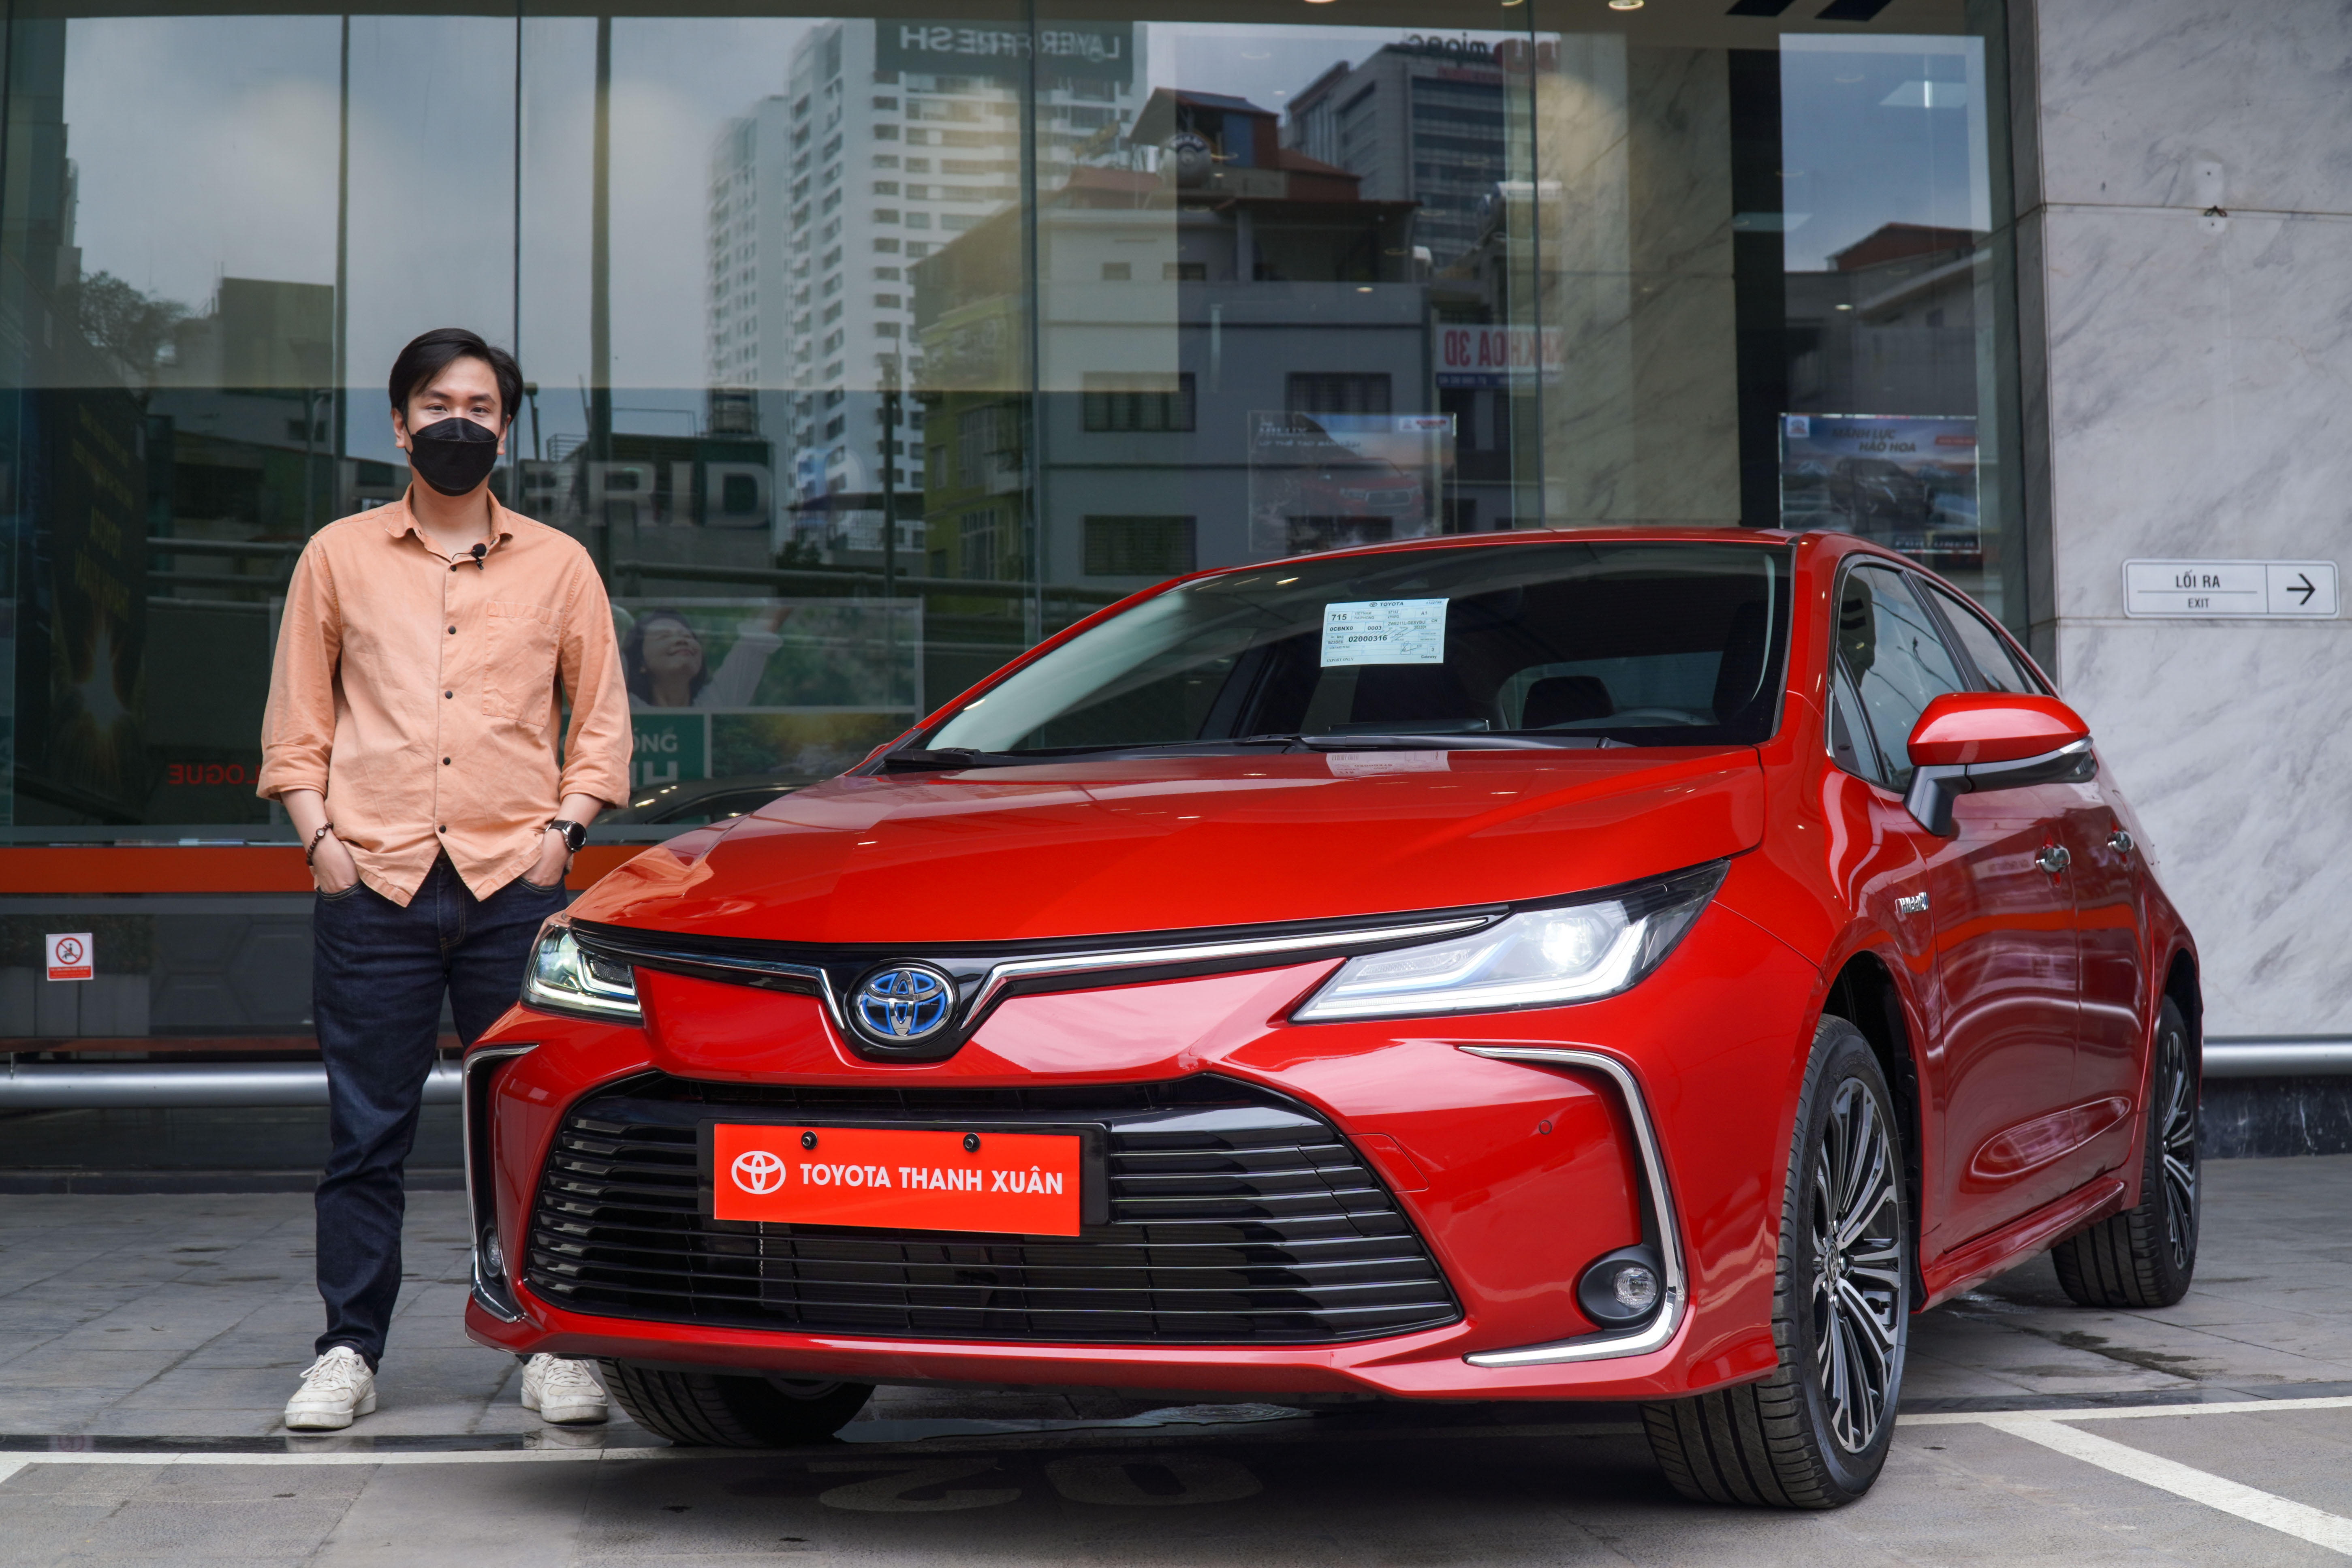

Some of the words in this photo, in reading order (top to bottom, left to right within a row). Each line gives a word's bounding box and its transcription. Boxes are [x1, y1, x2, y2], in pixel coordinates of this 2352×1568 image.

[2176, 569, 2196, 588] LỐI
[2203, 575, 2220, 588] RA
[2188, 598, 2209, 608] EXIT
[799, 1163, 892, 1188] TOYOTA
[898, 1167, 983, 1191] THANH
[990, 1165, 1063, 1194] XUÂN
